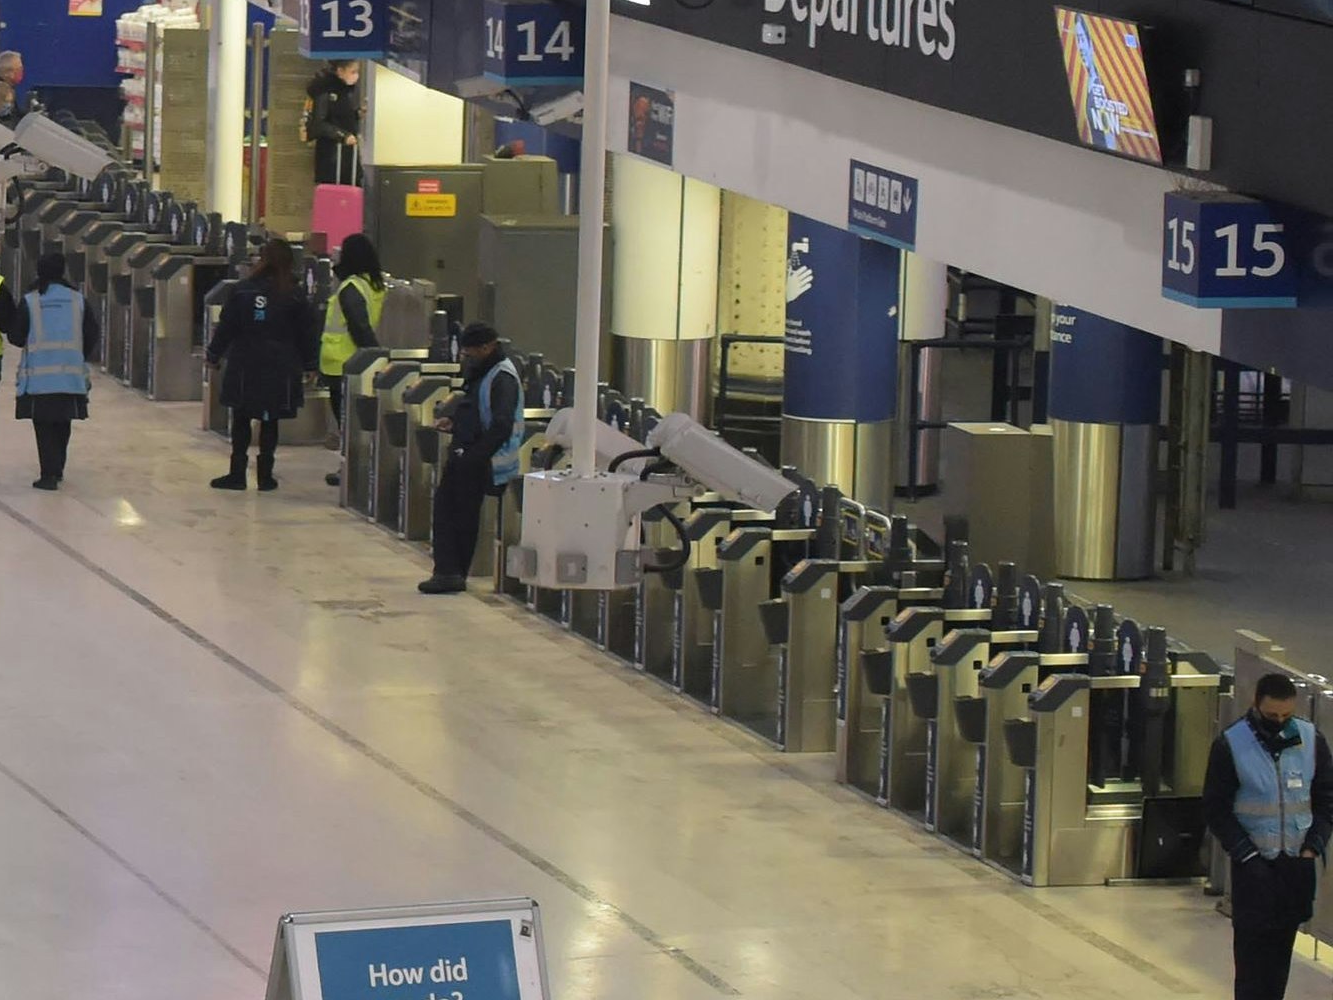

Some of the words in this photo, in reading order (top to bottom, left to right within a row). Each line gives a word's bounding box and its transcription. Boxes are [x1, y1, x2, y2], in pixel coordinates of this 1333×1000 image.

[320, 0, 374, 38] 13
[486, 17, 505, 58] 14
[517, 20, 575, 62] 14
[1091, 108, 1120, 135] NOW
[1093, 97, 1128, 116] BOOSTED
[1167, 217, 1195, 275] 15
[1215, 223, 1285, 278] 15
[1058, 315, 1076, 327] your
[368, 963, 425, 988] How
[429, 957, 468, 983] did
